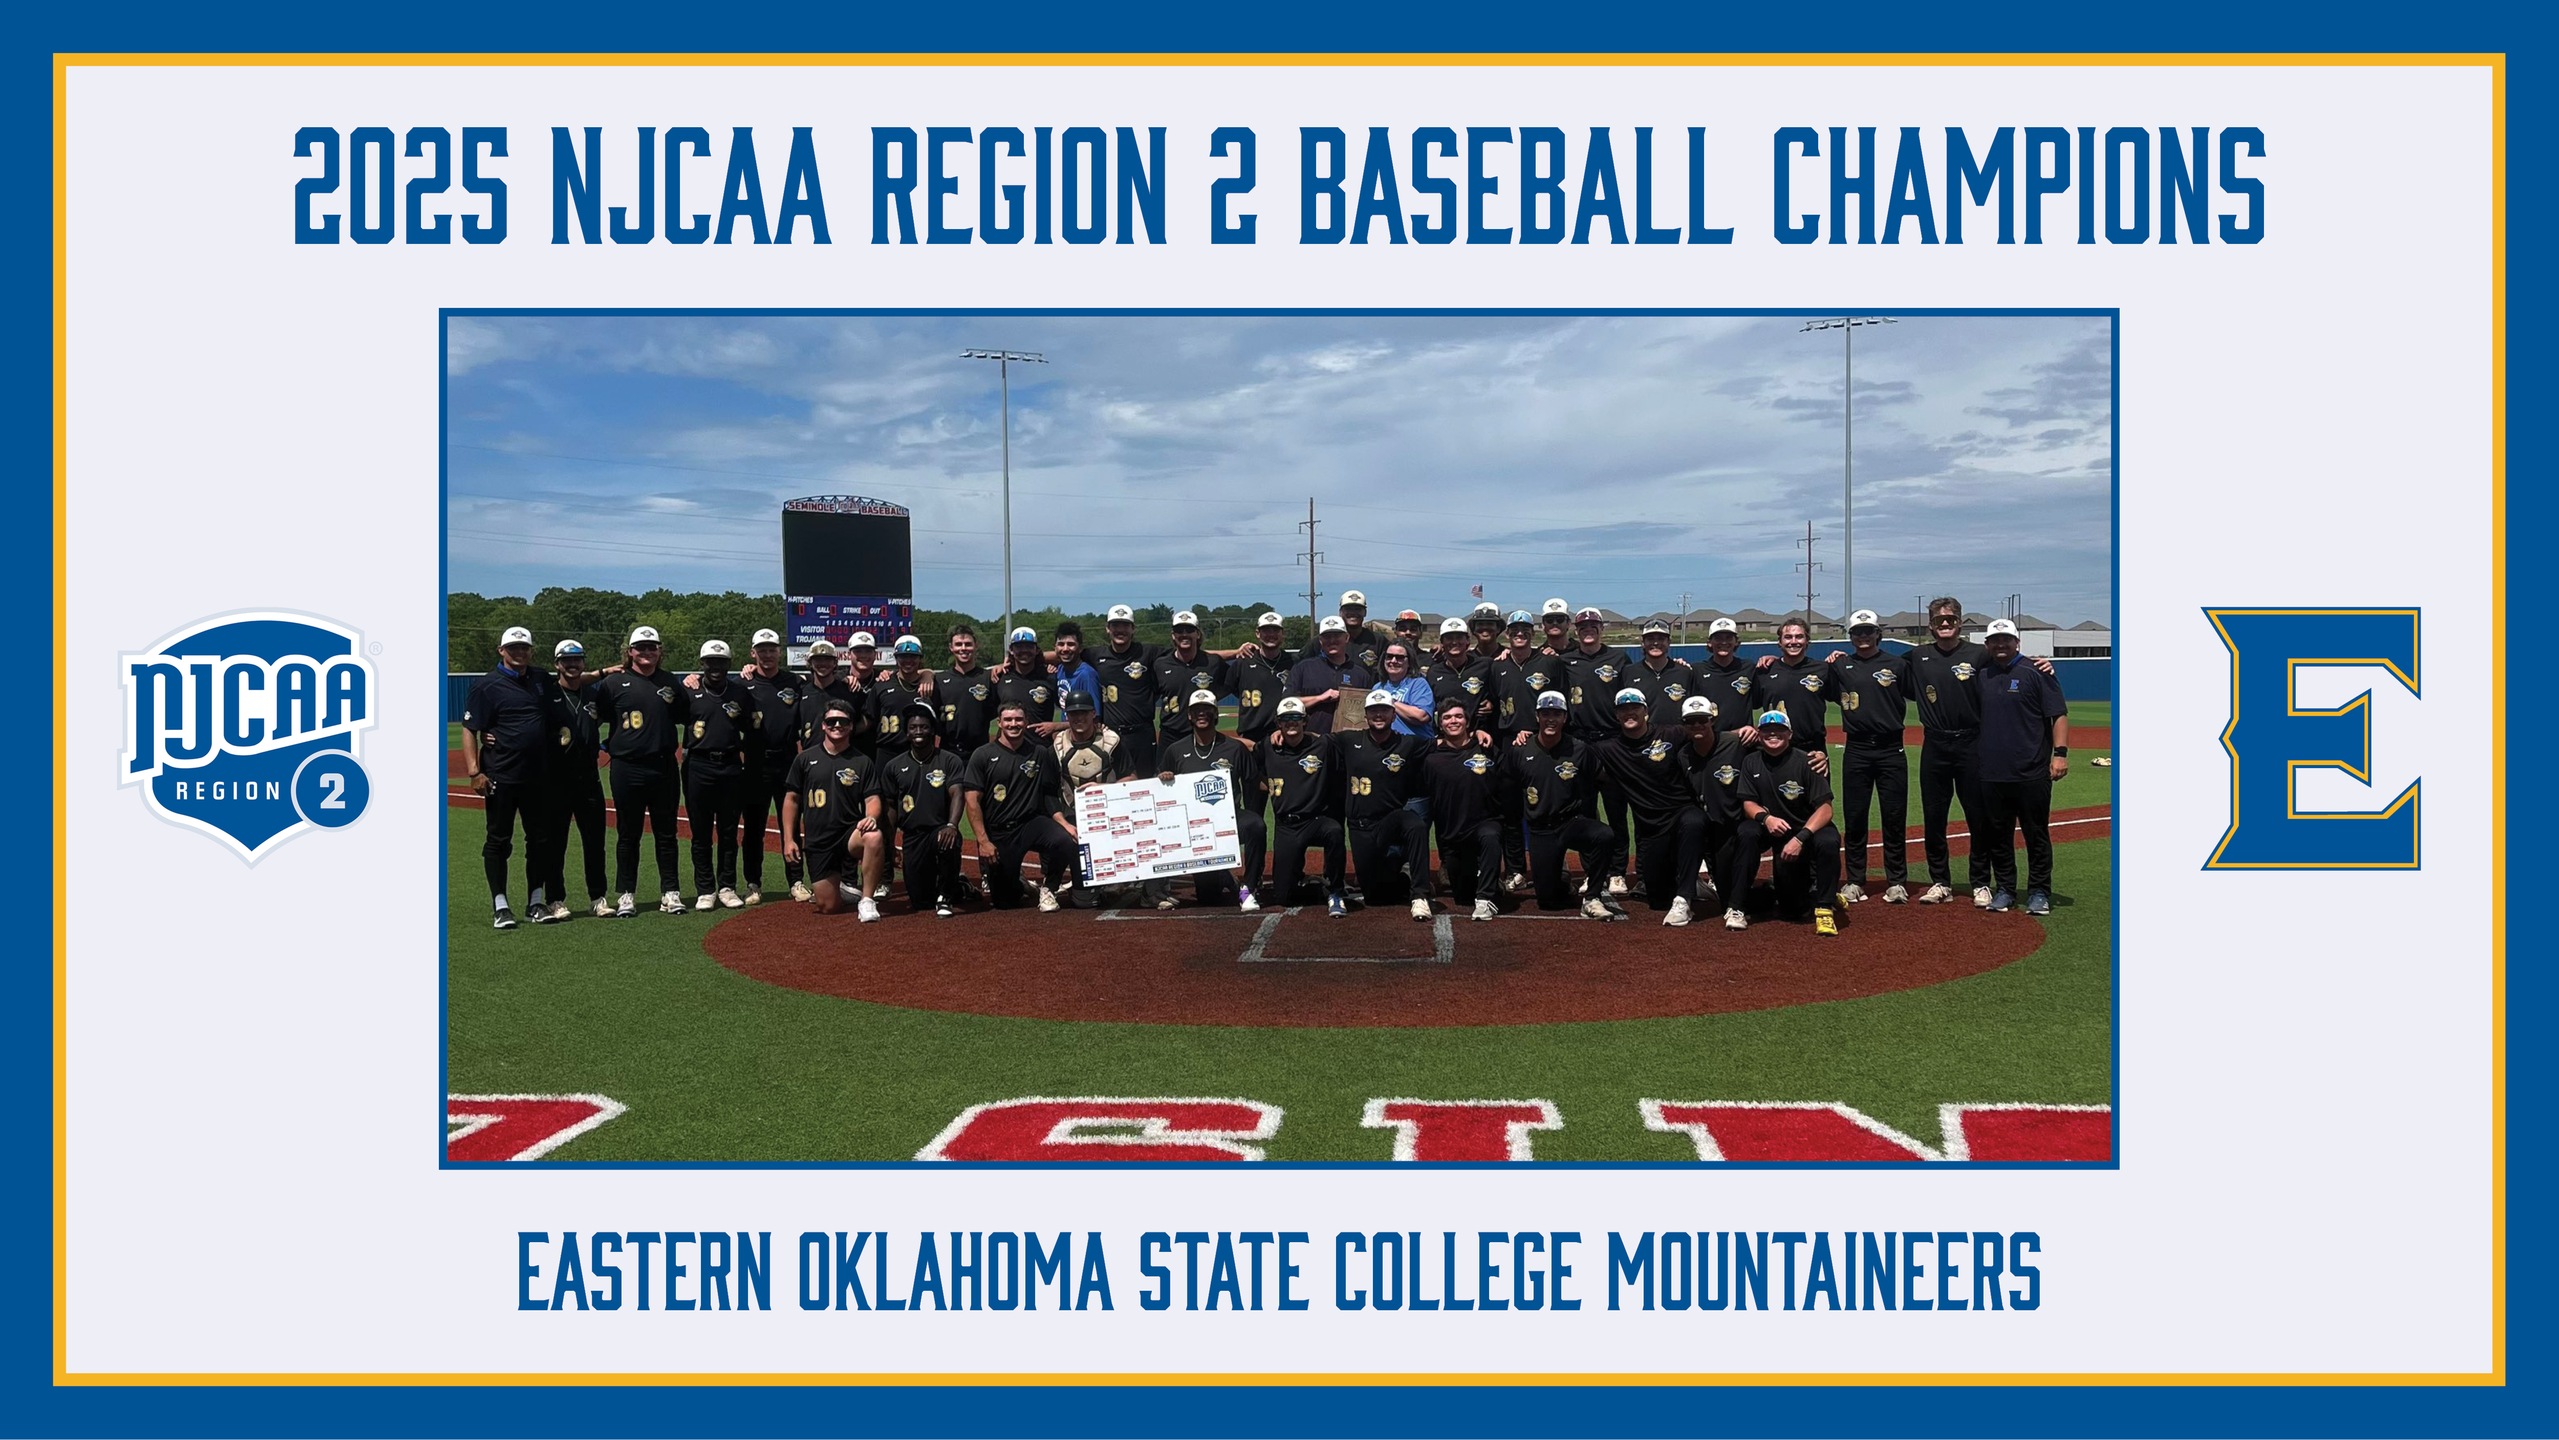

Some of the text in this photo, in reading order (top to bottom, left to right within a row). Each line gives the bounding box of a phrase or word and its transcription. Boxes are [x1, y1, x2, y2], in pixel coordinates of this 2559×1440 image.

[788, 501, 835, 512] SEMINOLE
[861, 506, 907, 516] BASEBALL
[816, 606, 830, 614] BALL
[843, 606, 861, 614] STRIKE
[1196, 781, 1226, 797] NJCAA
[808, 788, 827, 808] 10
